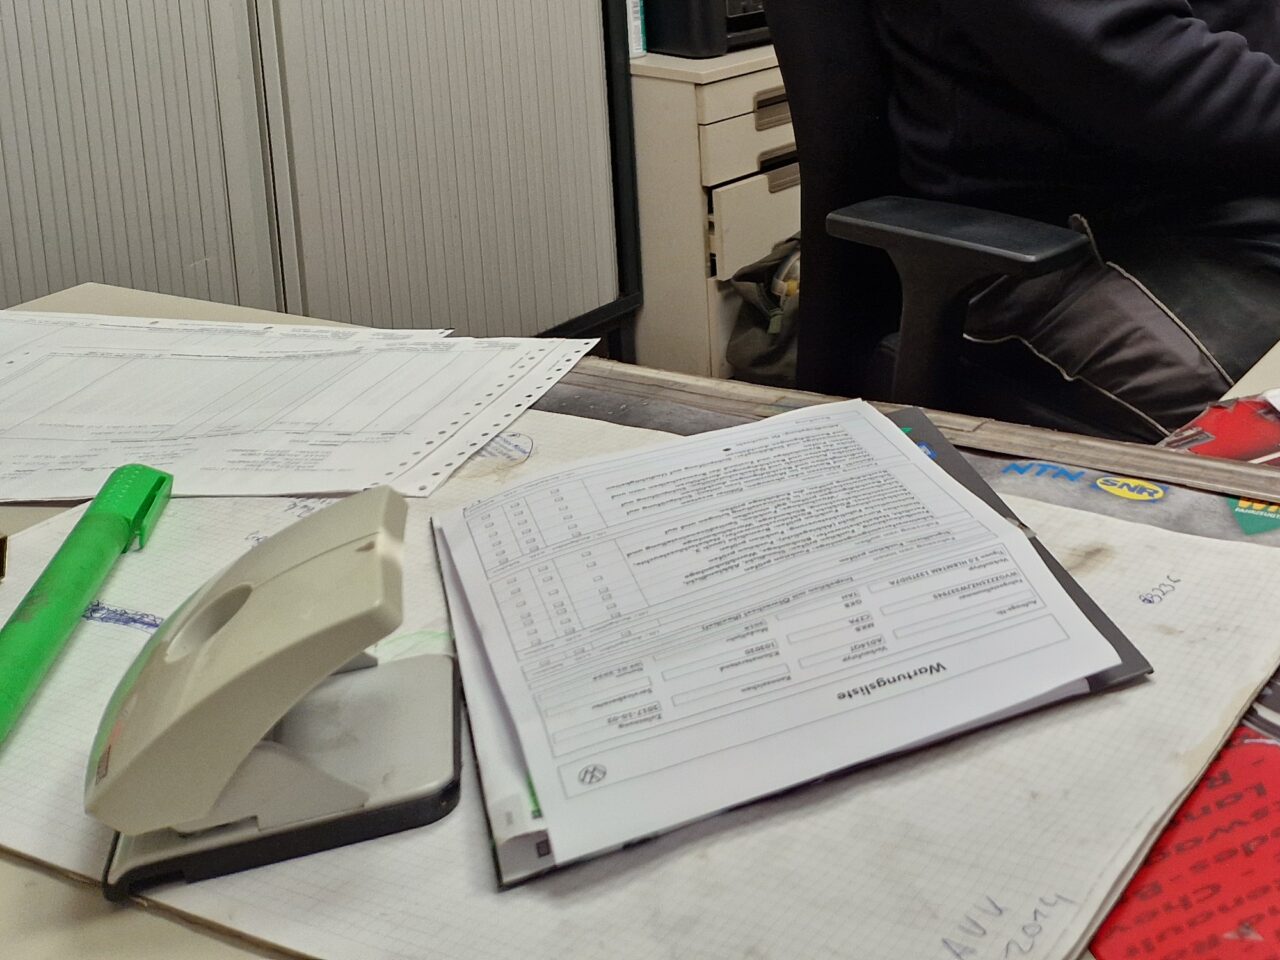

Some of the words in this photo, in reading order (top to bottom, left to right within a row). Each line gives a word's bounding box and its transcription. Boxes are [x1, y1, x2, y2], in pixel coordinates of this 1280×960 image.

[1001, 463, 1086, 482] NTN
[1099, 477, 1162, 499] SNR
[833, 657, 947, 705] Wartungsliste
